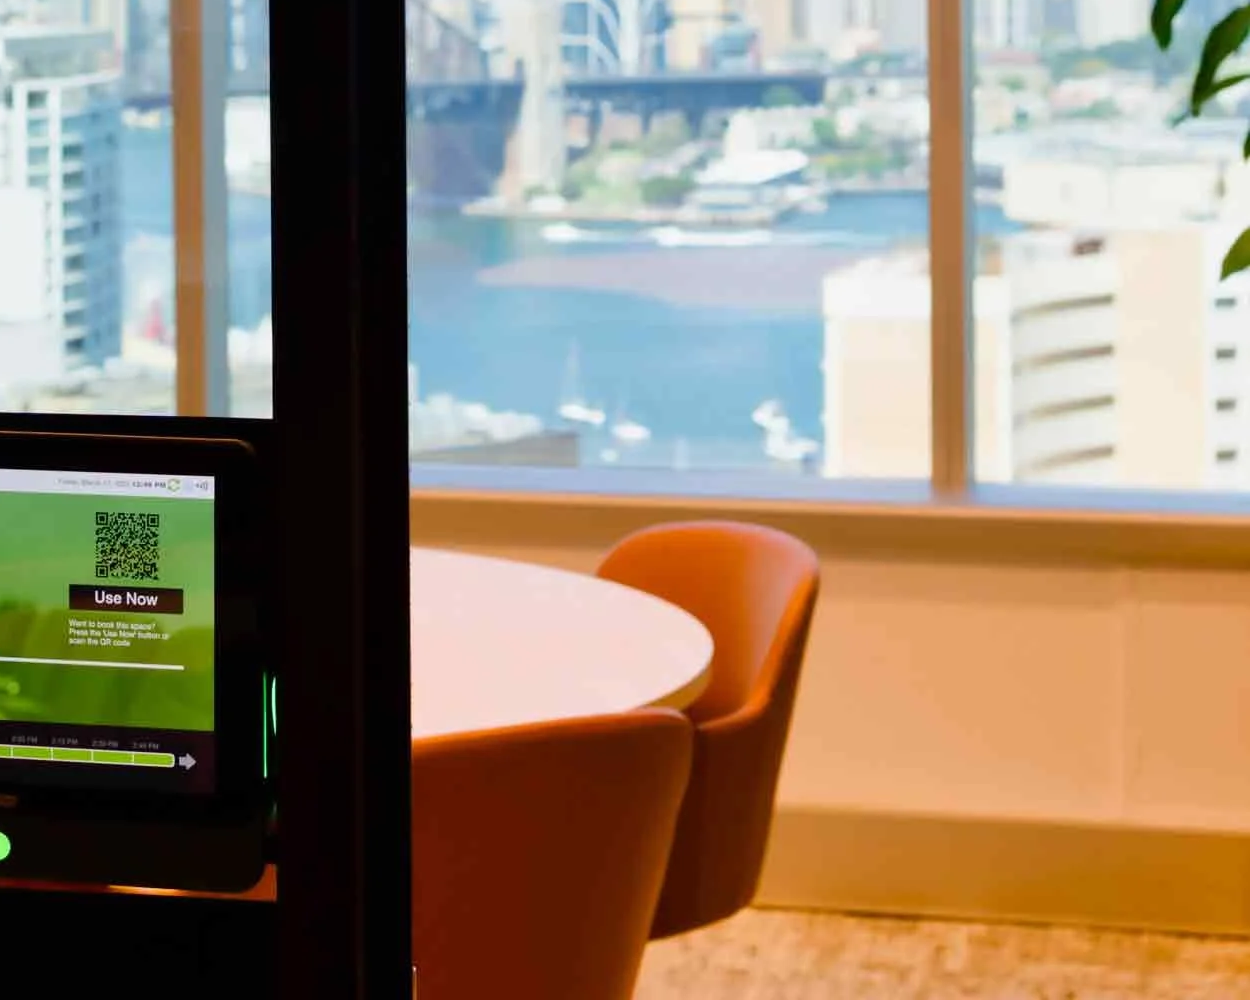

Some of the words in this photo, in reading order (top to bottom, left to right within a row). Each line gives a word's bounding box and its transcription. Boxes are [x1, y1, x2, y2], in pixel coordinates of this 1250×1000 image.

[94, 590, 122, 605] Use
[126, 591, 159, 606] Now
[68, 618, 87, 627] Want
[89, 619, 96, 628] to
[97, 620, 114, 629] book
[116, 621, 129, 629] this
[69, 628, 88, 636] Press
[90, 629, 101, 637] the
[87, 637, 98, 645] the
[100, 638, 111, 646] QR
[113, 639, 130, 647] code
